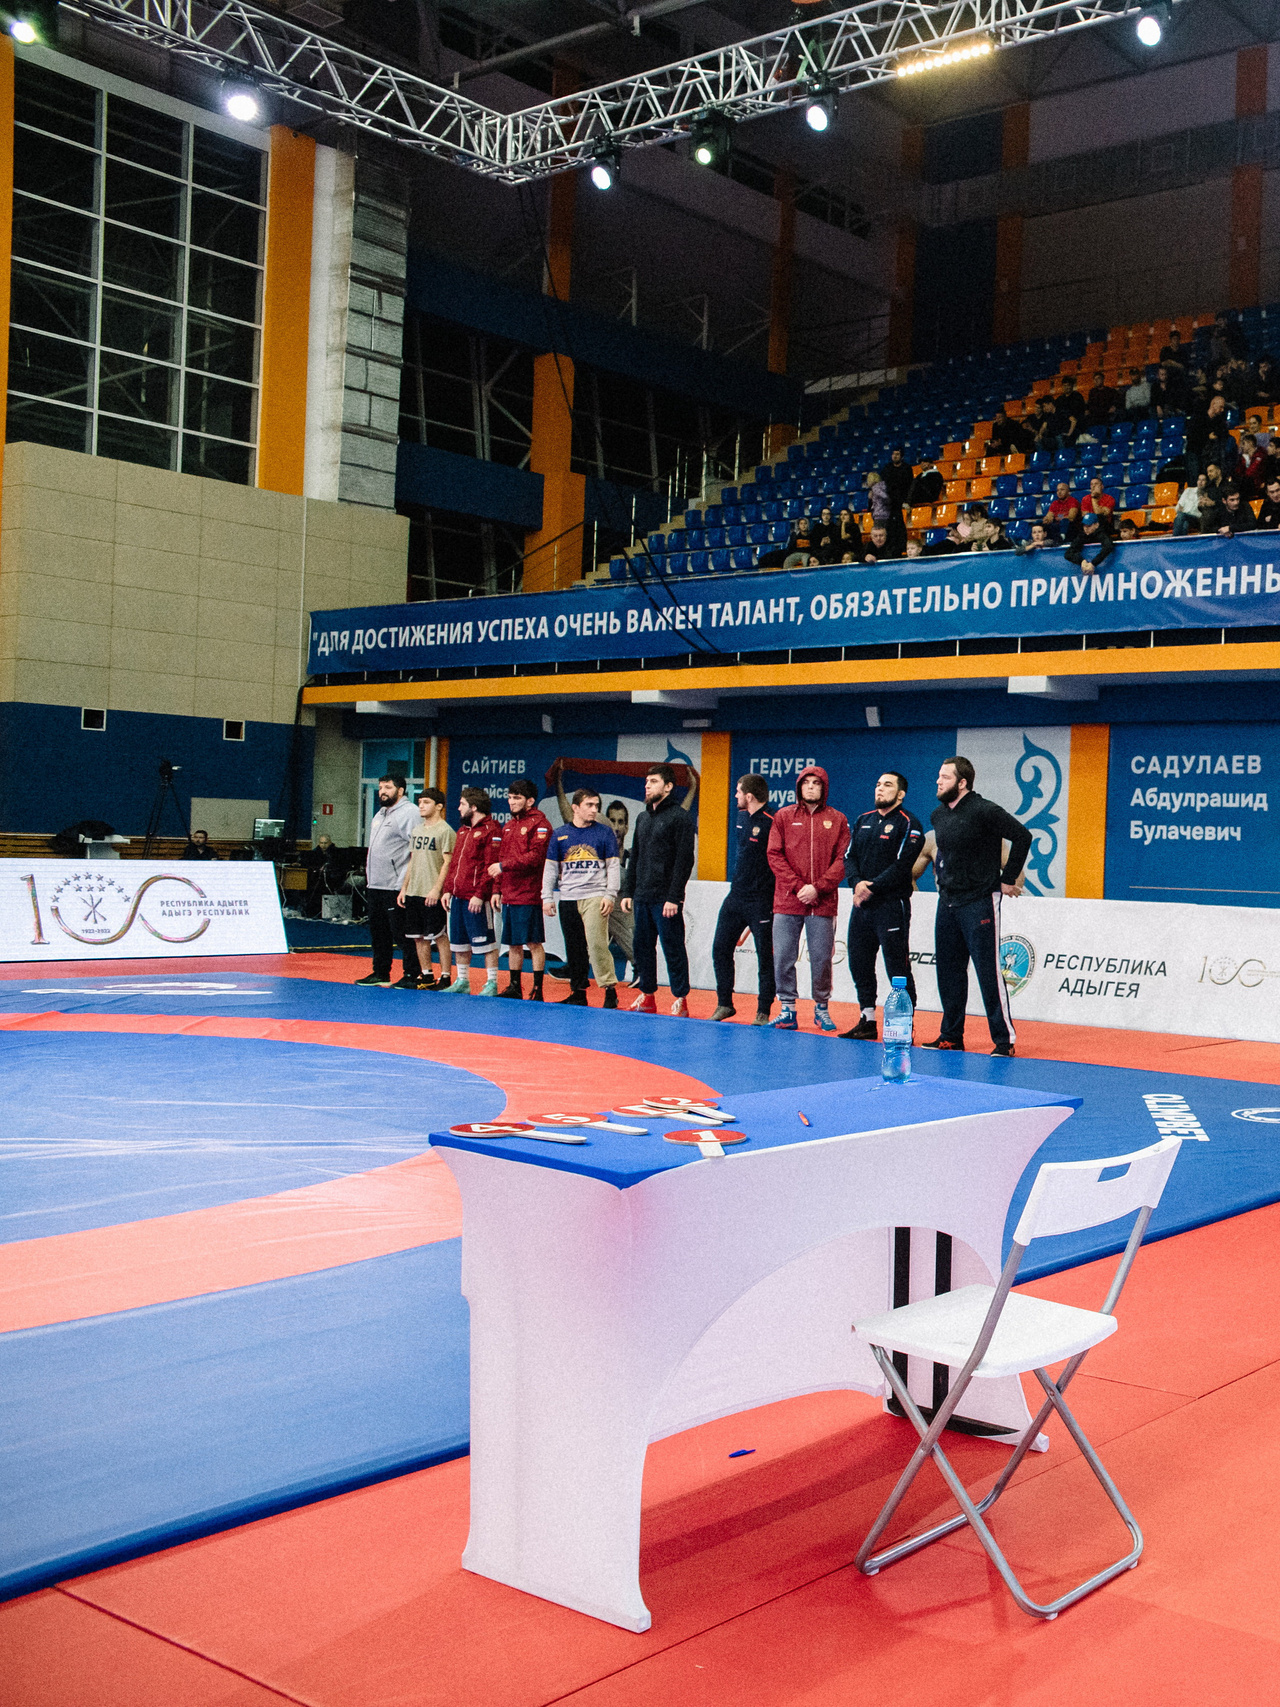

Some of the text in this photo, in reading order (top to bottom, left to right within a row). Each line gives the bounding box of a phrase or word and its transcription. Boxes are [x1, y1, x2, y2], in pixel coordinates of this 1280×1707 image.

[312, 629, 350, 656] "ДЛЯ
[351, 620, 473, 654] ДОСТИЖЕНИЯ
[477, 615, 549, 643] УСПЕХА
[554, 610, 620, 637] ОЧЕНЬ
[626, 604, 703, 634] ВАЖЕН
[708, 596, 804, 628] ТАЛАНТ,
[810, 581, 1003, 621] ОБЯЗАТЕЛЬНО
[462, 756, 526, 774] САЙТИЕВ
[1130, 754, 1262, 779] САДУЛАЕВ
[1129, 787, 1269, 813] Абдулрашид
[1129, 819, 1242, 845] Булачевич
[197, 908, 250, 917] РЕСПУБЛИК
[217, 899, 249, 908] АДЫГЕЯ
[1043, 953, 1168, 977] РЕСПУБЛИКА
[1058, 977, 1140, 999] АДЫГЕЯ
[660, 1096, 705, 1107] 2
[469, 1122, 523, 1133] 4
[691, 1130, 720, 1142] 1
